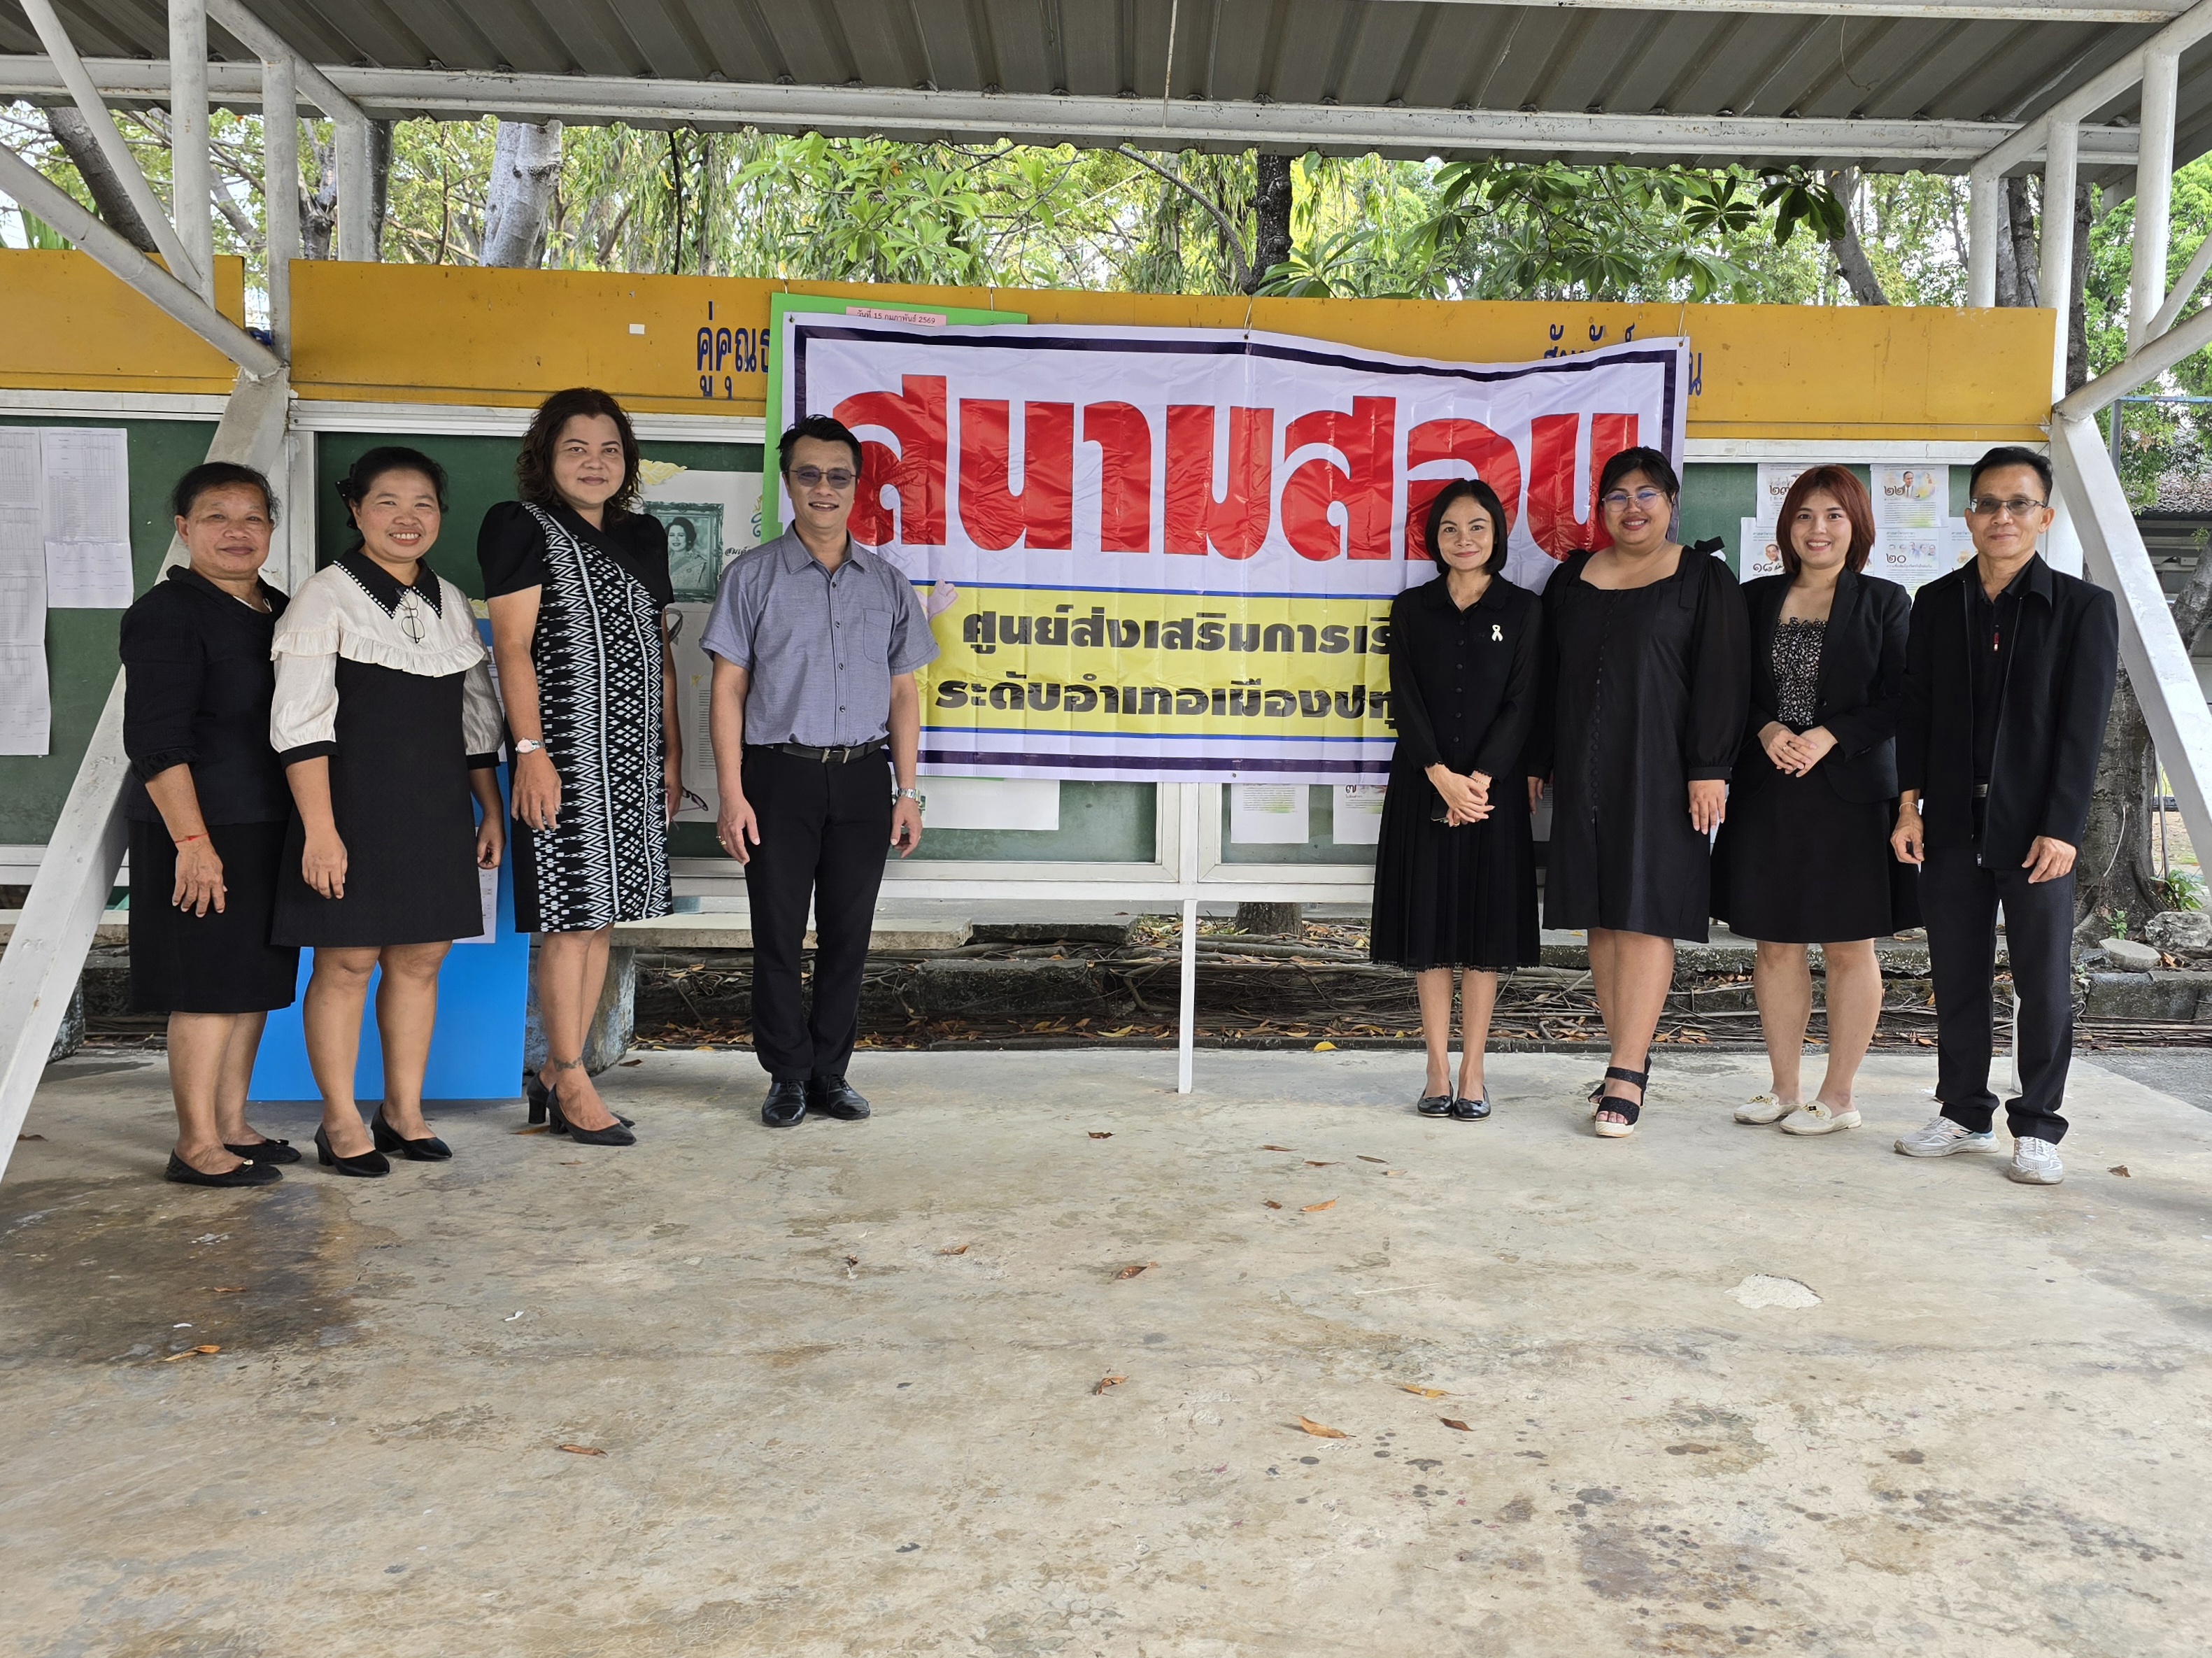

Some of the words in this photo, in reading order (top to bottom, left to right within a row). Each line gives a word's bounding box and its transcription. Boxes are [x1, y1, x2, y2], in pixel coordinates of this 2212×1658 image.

[857, 309, 872, 318] วันที่
[884, 313, 916, 323] กมภาพันธ์
[919, 316, 936, 325] 2569
[832, 374, 1639, 562] สนามสอบ
[1884, 486, 1905, 496] ๒๒
[1886, 553, 1907, 563] ๒๐
